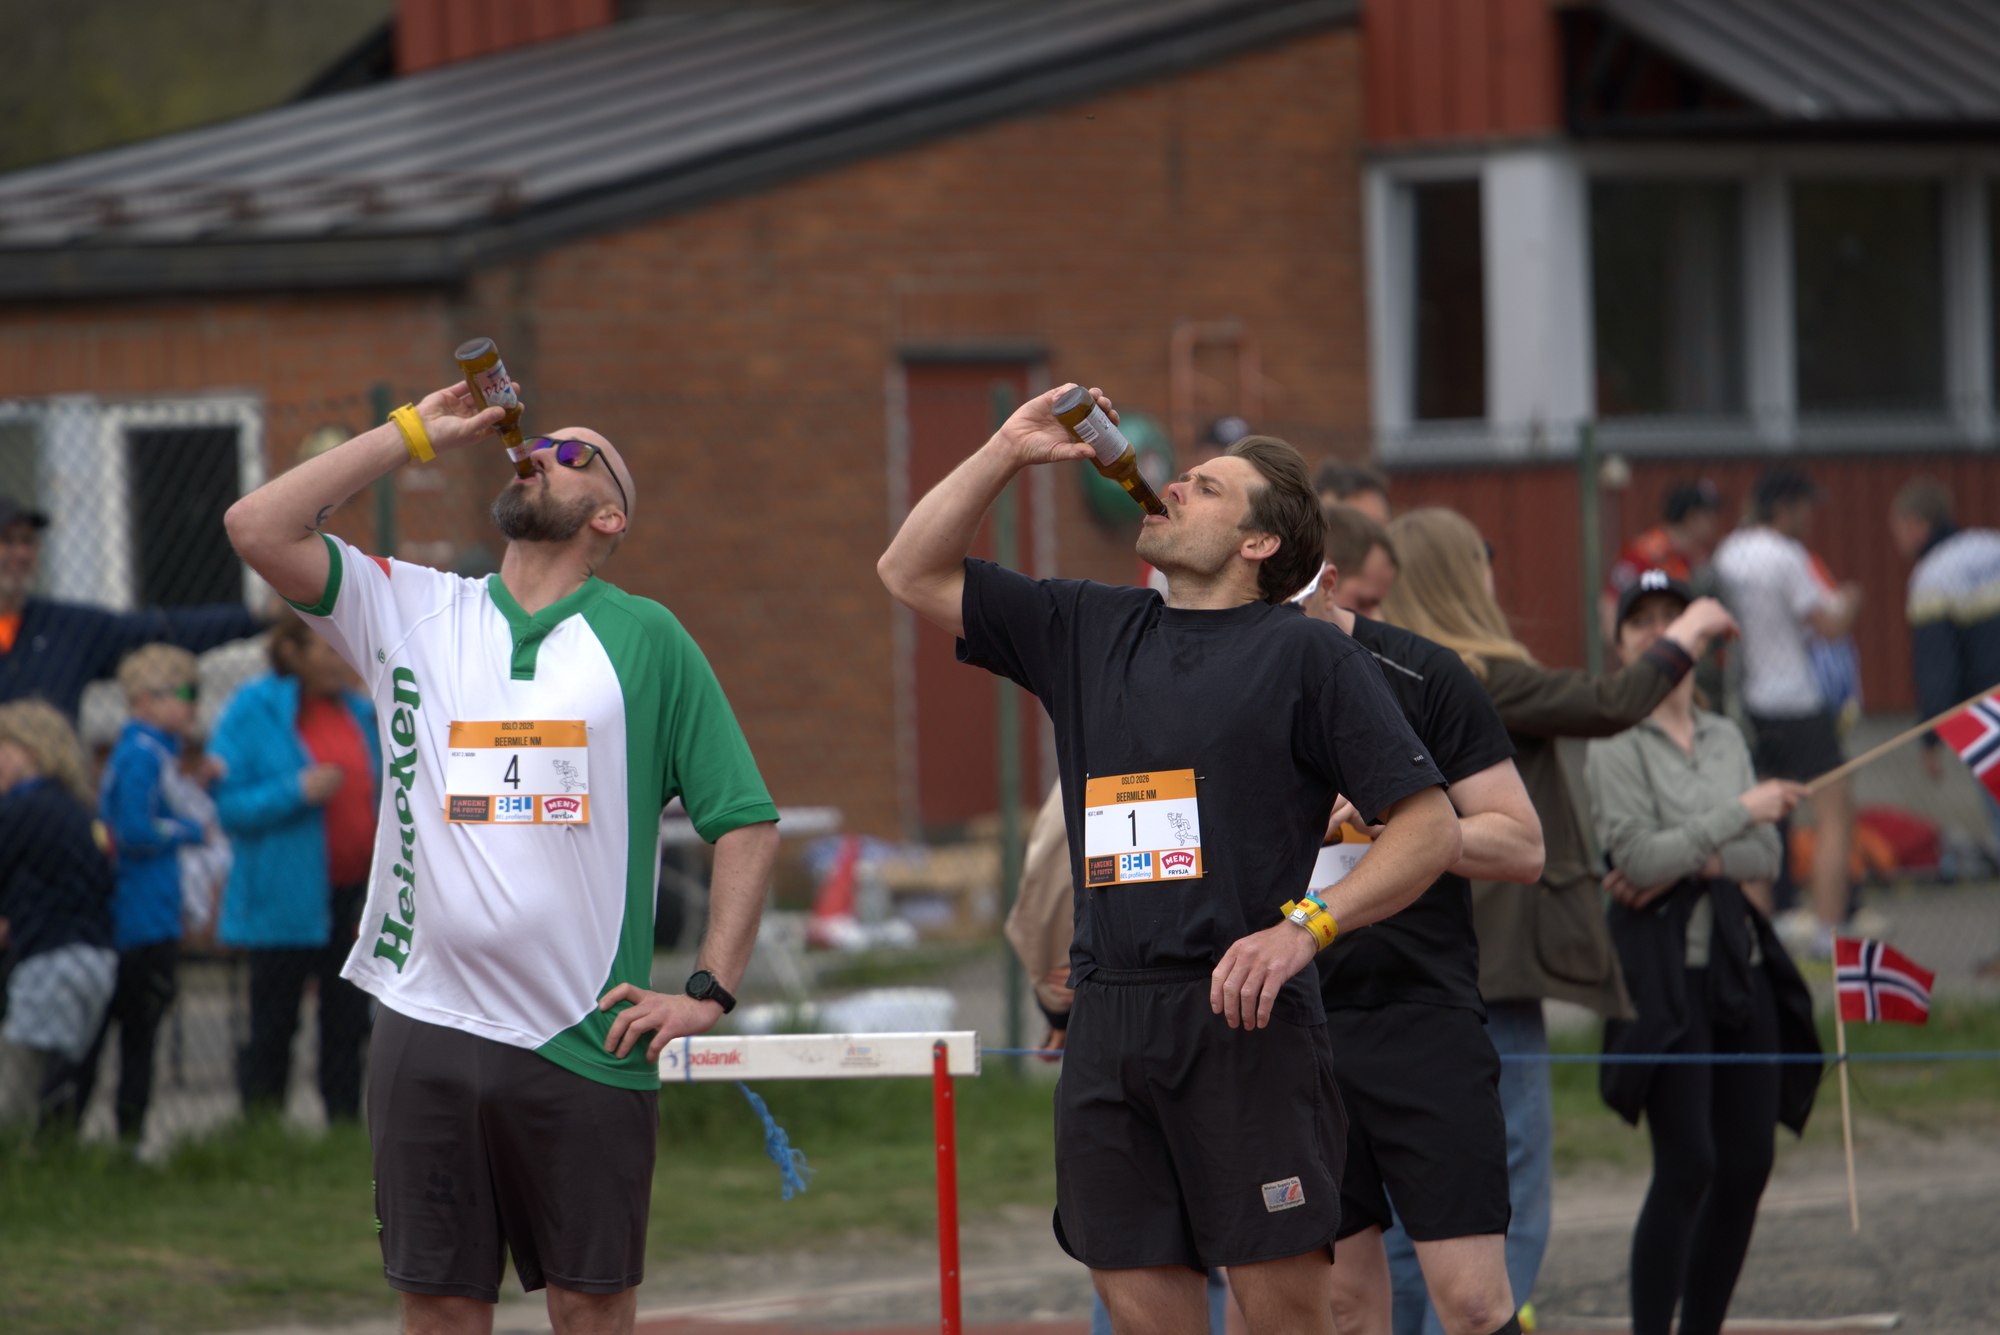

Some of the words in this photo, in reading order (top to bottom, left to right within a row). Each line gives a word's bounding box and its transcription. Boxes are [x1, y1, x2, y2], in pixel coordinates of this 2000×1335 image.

[502, 722, 518, 730] OSLO
[519, 722, 534, 730] 2026
[495, 737, 528, 746] BEERMILE
[530, 736, 542, 746] NM
[504, 754, 521, 790] 4
[1121, 775, 1135, 785] OSLO
[1136, 775, 1150, 784] 2026
[1116, 790, 1145, 802] BEERMILE
[1146, 789, 1157, 800] NM
[497, 796, 532, 813] BEL
[549, 800, 577, 810] MENY
[1128, 809, 1137, 847] 1
[1121, 853, 1152, 871] BEL
[1166, 855, 1191, 865] MENY
